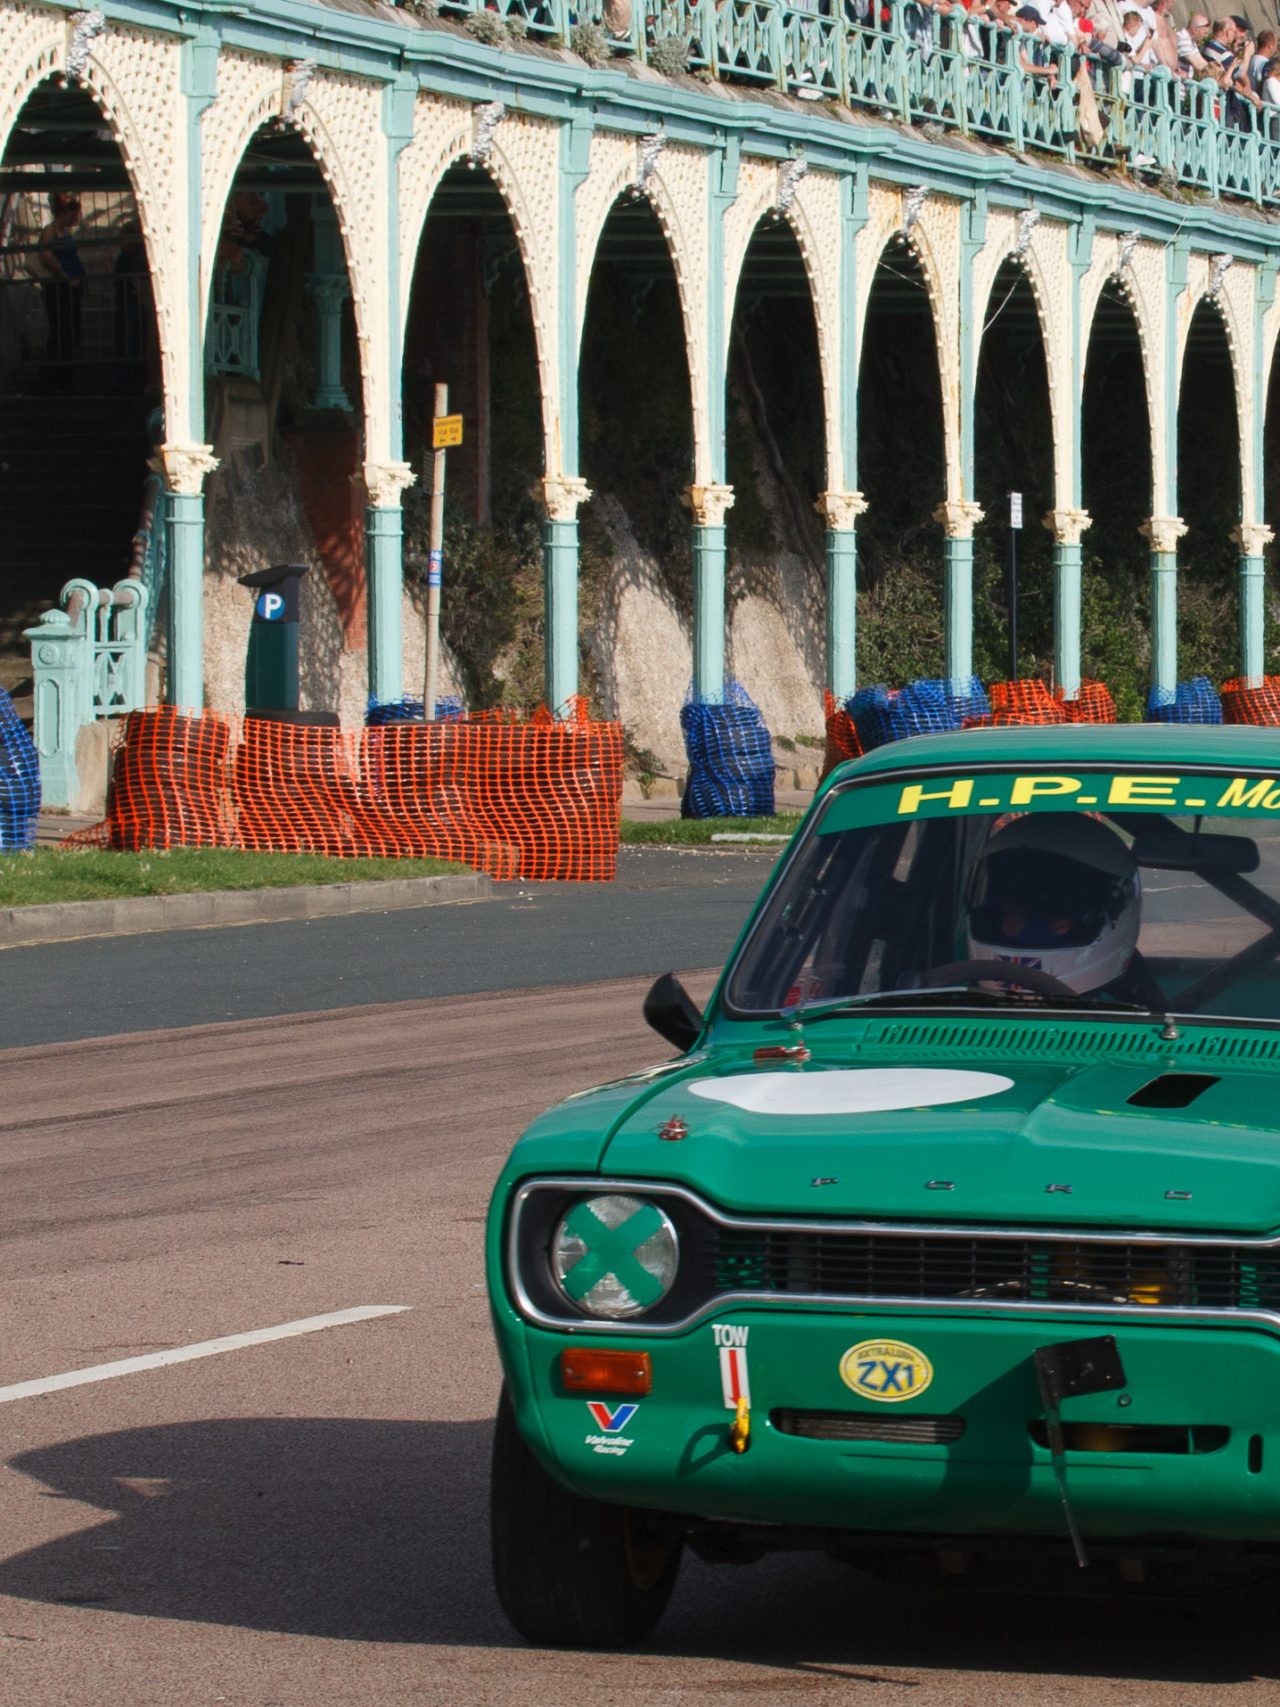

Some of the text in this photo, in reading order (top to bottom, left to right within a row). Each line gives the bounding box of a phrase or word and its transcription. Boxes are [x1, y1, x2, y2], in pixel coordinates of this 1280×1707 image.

[264, 593, 282, 619] P
[897, 776, 1206, 815] H.P.E.
[811, 1177, 1193, 1201] FORD
[711, 1323, 749, 1347] TOW
[857, 1361, 914, 1392] ZX1
